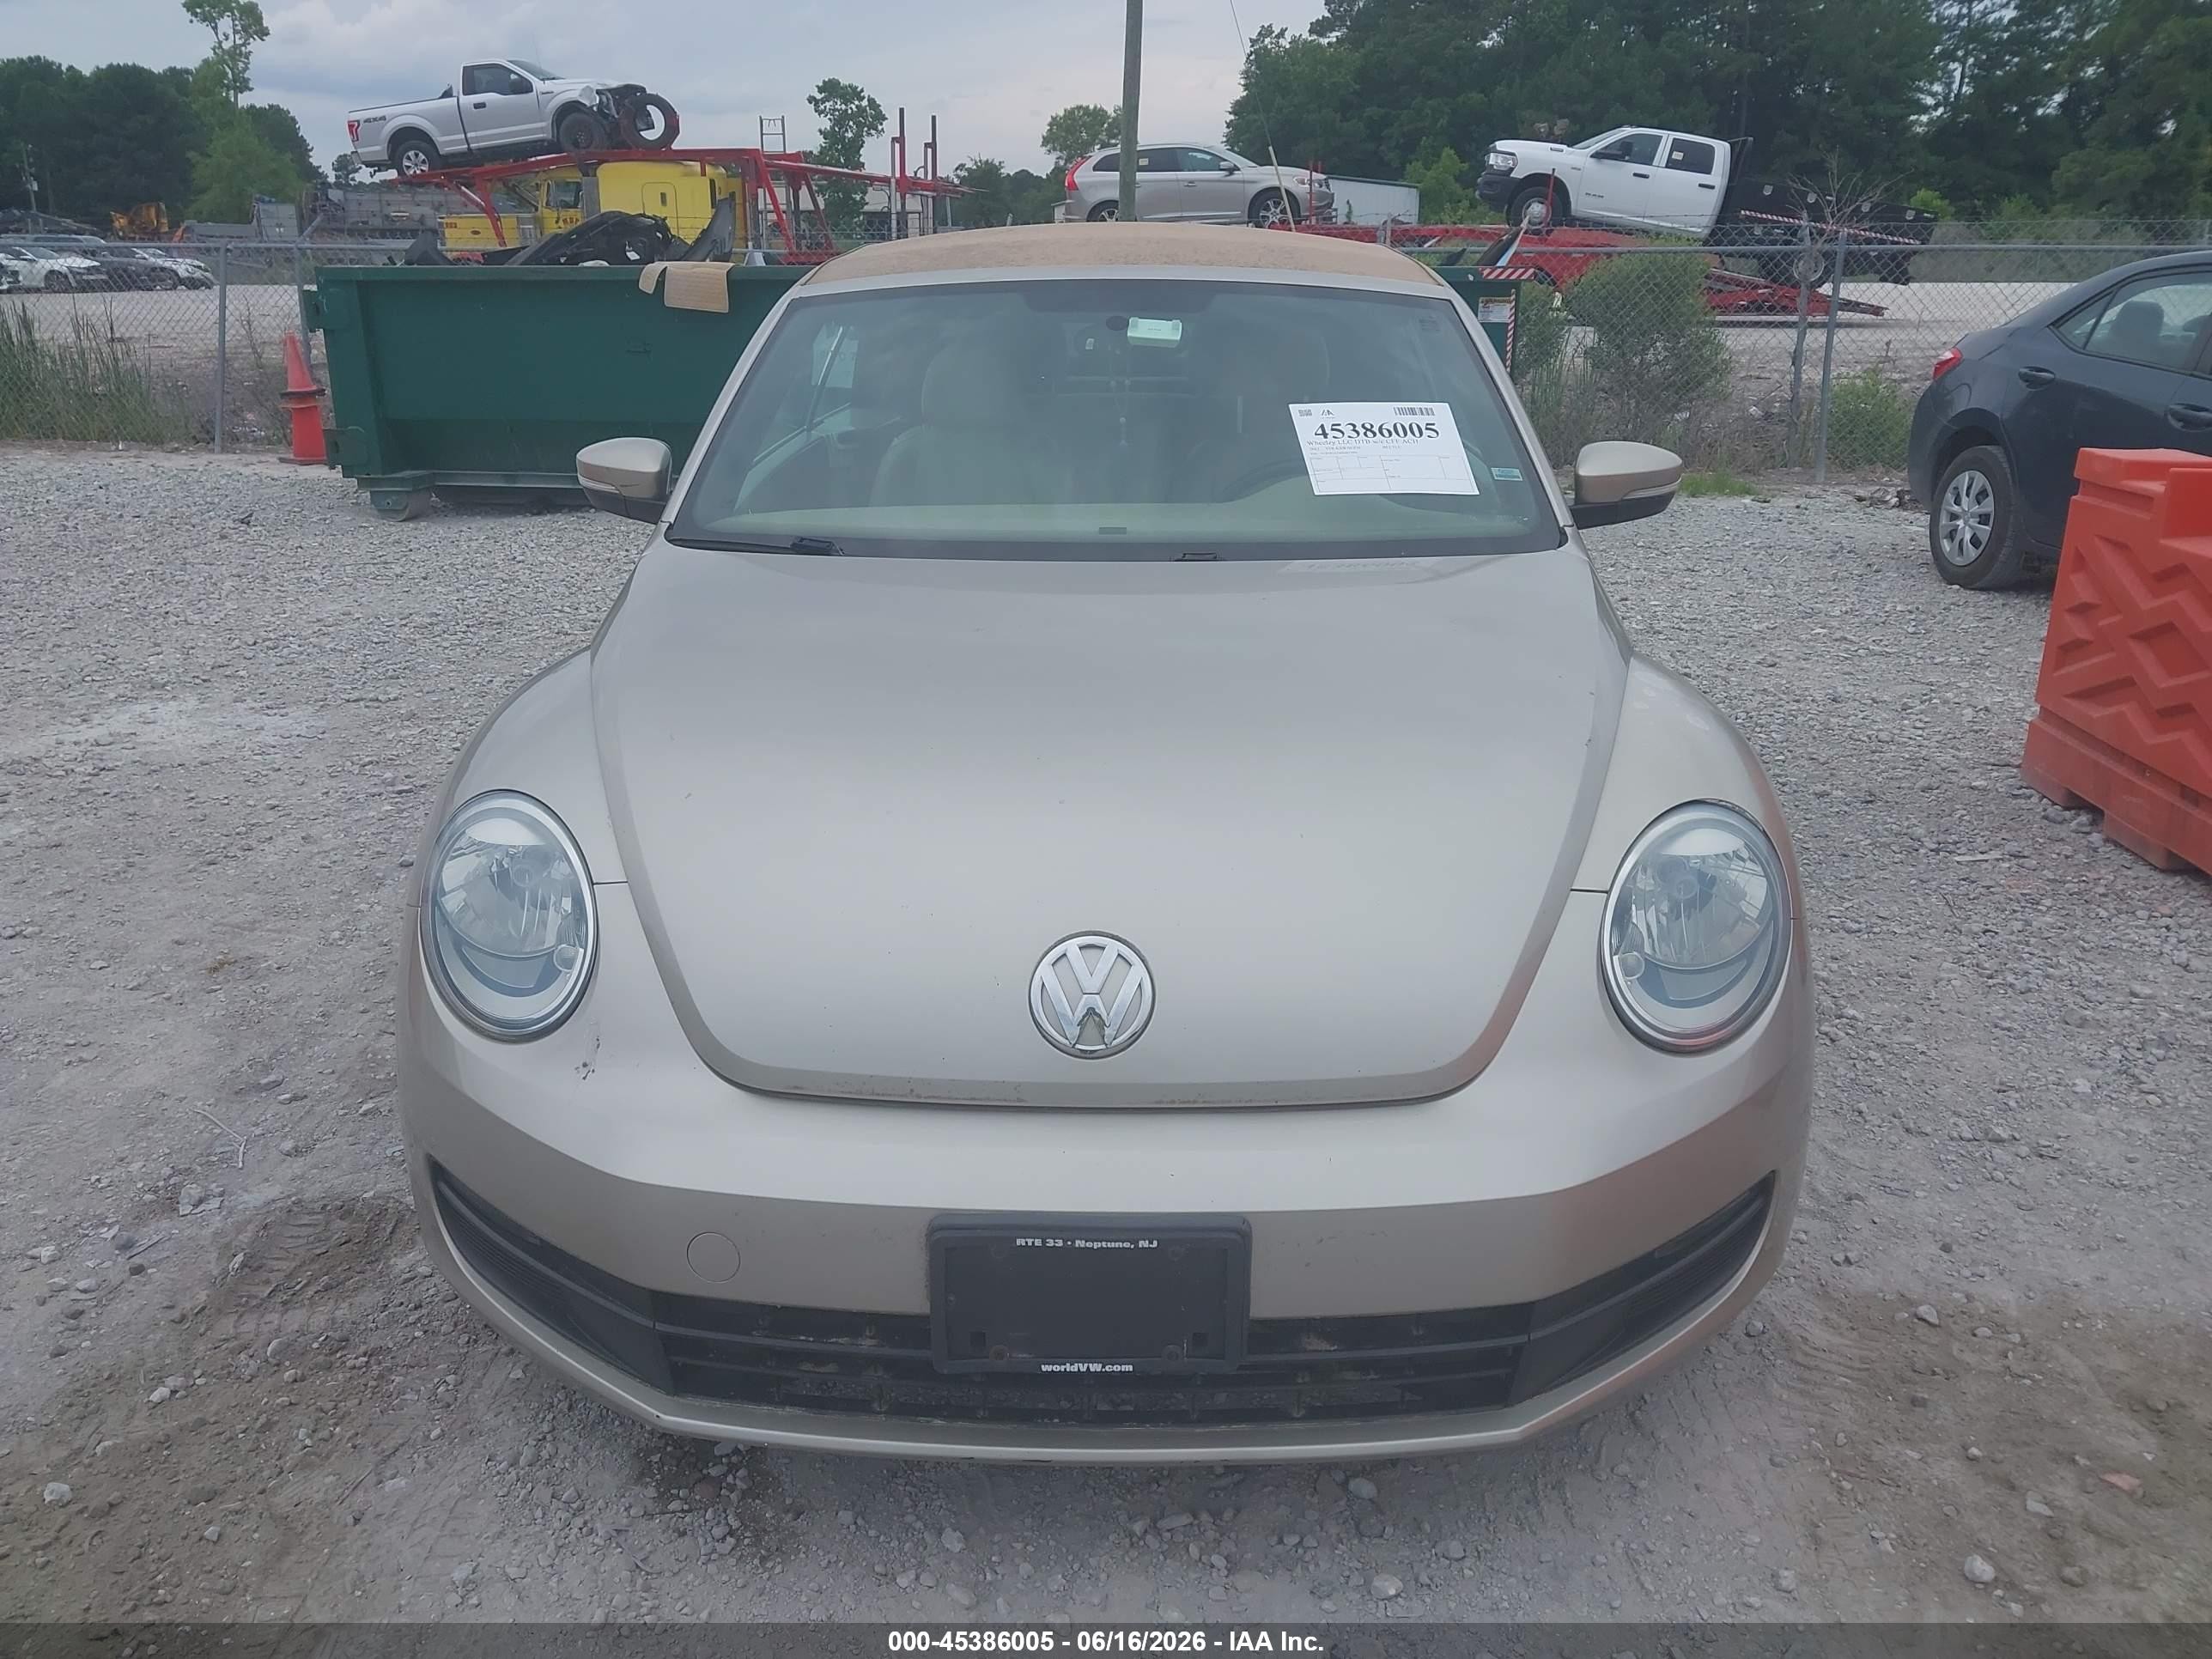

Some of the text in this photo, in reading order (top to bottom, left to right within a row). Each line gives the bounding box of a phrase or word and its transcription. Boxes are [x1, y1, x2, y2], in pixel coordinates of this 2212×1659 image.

[1314, 422, 1439, 440] 45386005
[1032, 935, 1152, 1055] VW
[1016, 1237, 1042, 1247] RTE
[1045, 1238, 1064, 1248] 33
[1074, 1239, 1135, 1249] Neptune,
[1138, 1239, 1158, 1249] NJ
[1041, 1362, 1133, 1372] worldVW.com
